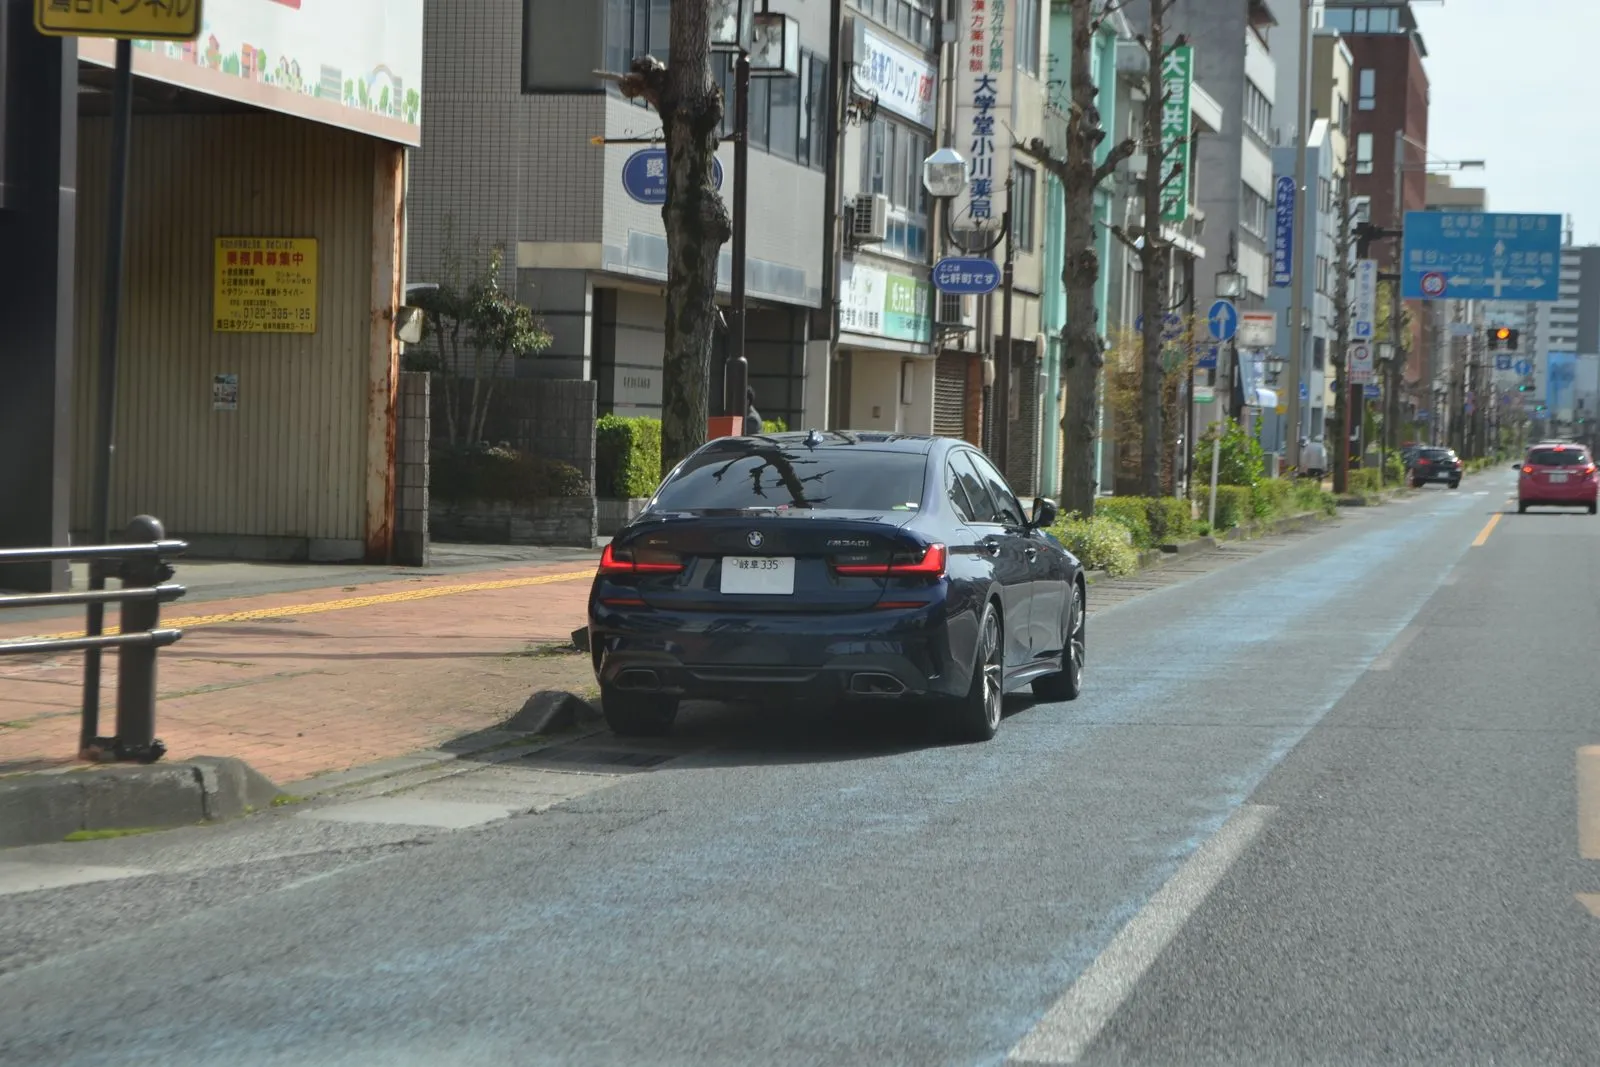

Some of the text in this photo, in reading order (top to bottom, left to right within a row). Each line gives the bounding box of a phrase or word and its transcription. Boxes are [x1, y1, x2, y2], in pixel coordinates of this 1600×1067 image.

[969, 75, 997, 219] 大学堂小川薬局
[939, 273, 994, 285] 七軒町です
[739, 560, 778, 569] 岐阜 335
